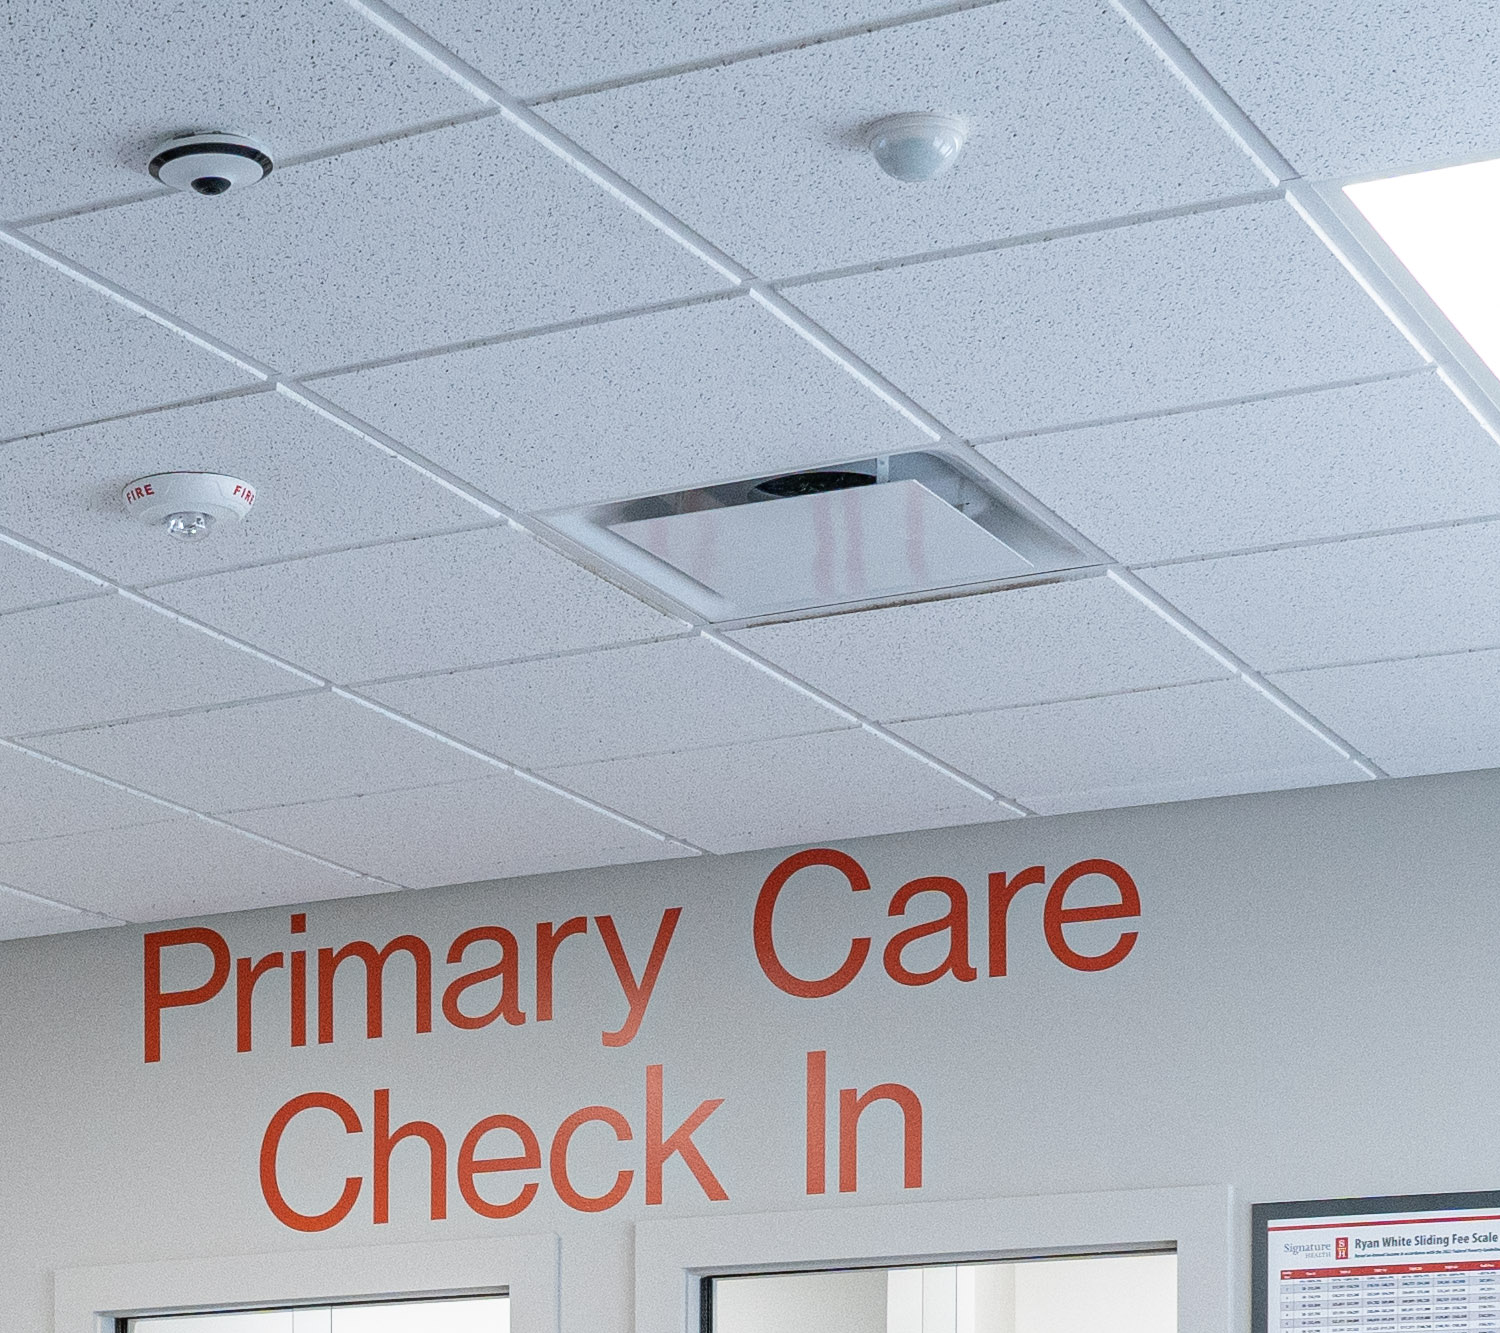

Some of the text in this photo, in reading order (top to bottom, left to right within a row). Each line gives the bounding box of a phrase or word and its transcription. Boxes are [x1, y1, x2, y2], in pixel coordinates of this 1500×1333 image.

[126, 484, 155, 504] FIRE
[144, 849, 1141, 1063] Primary Care
[259, 1050, 922, 1233] Check In
[1283, 1243, 1331, 1255] Signature
[1355, 1232, 1498, 1251] Ryan White Sliding Fee Scale
